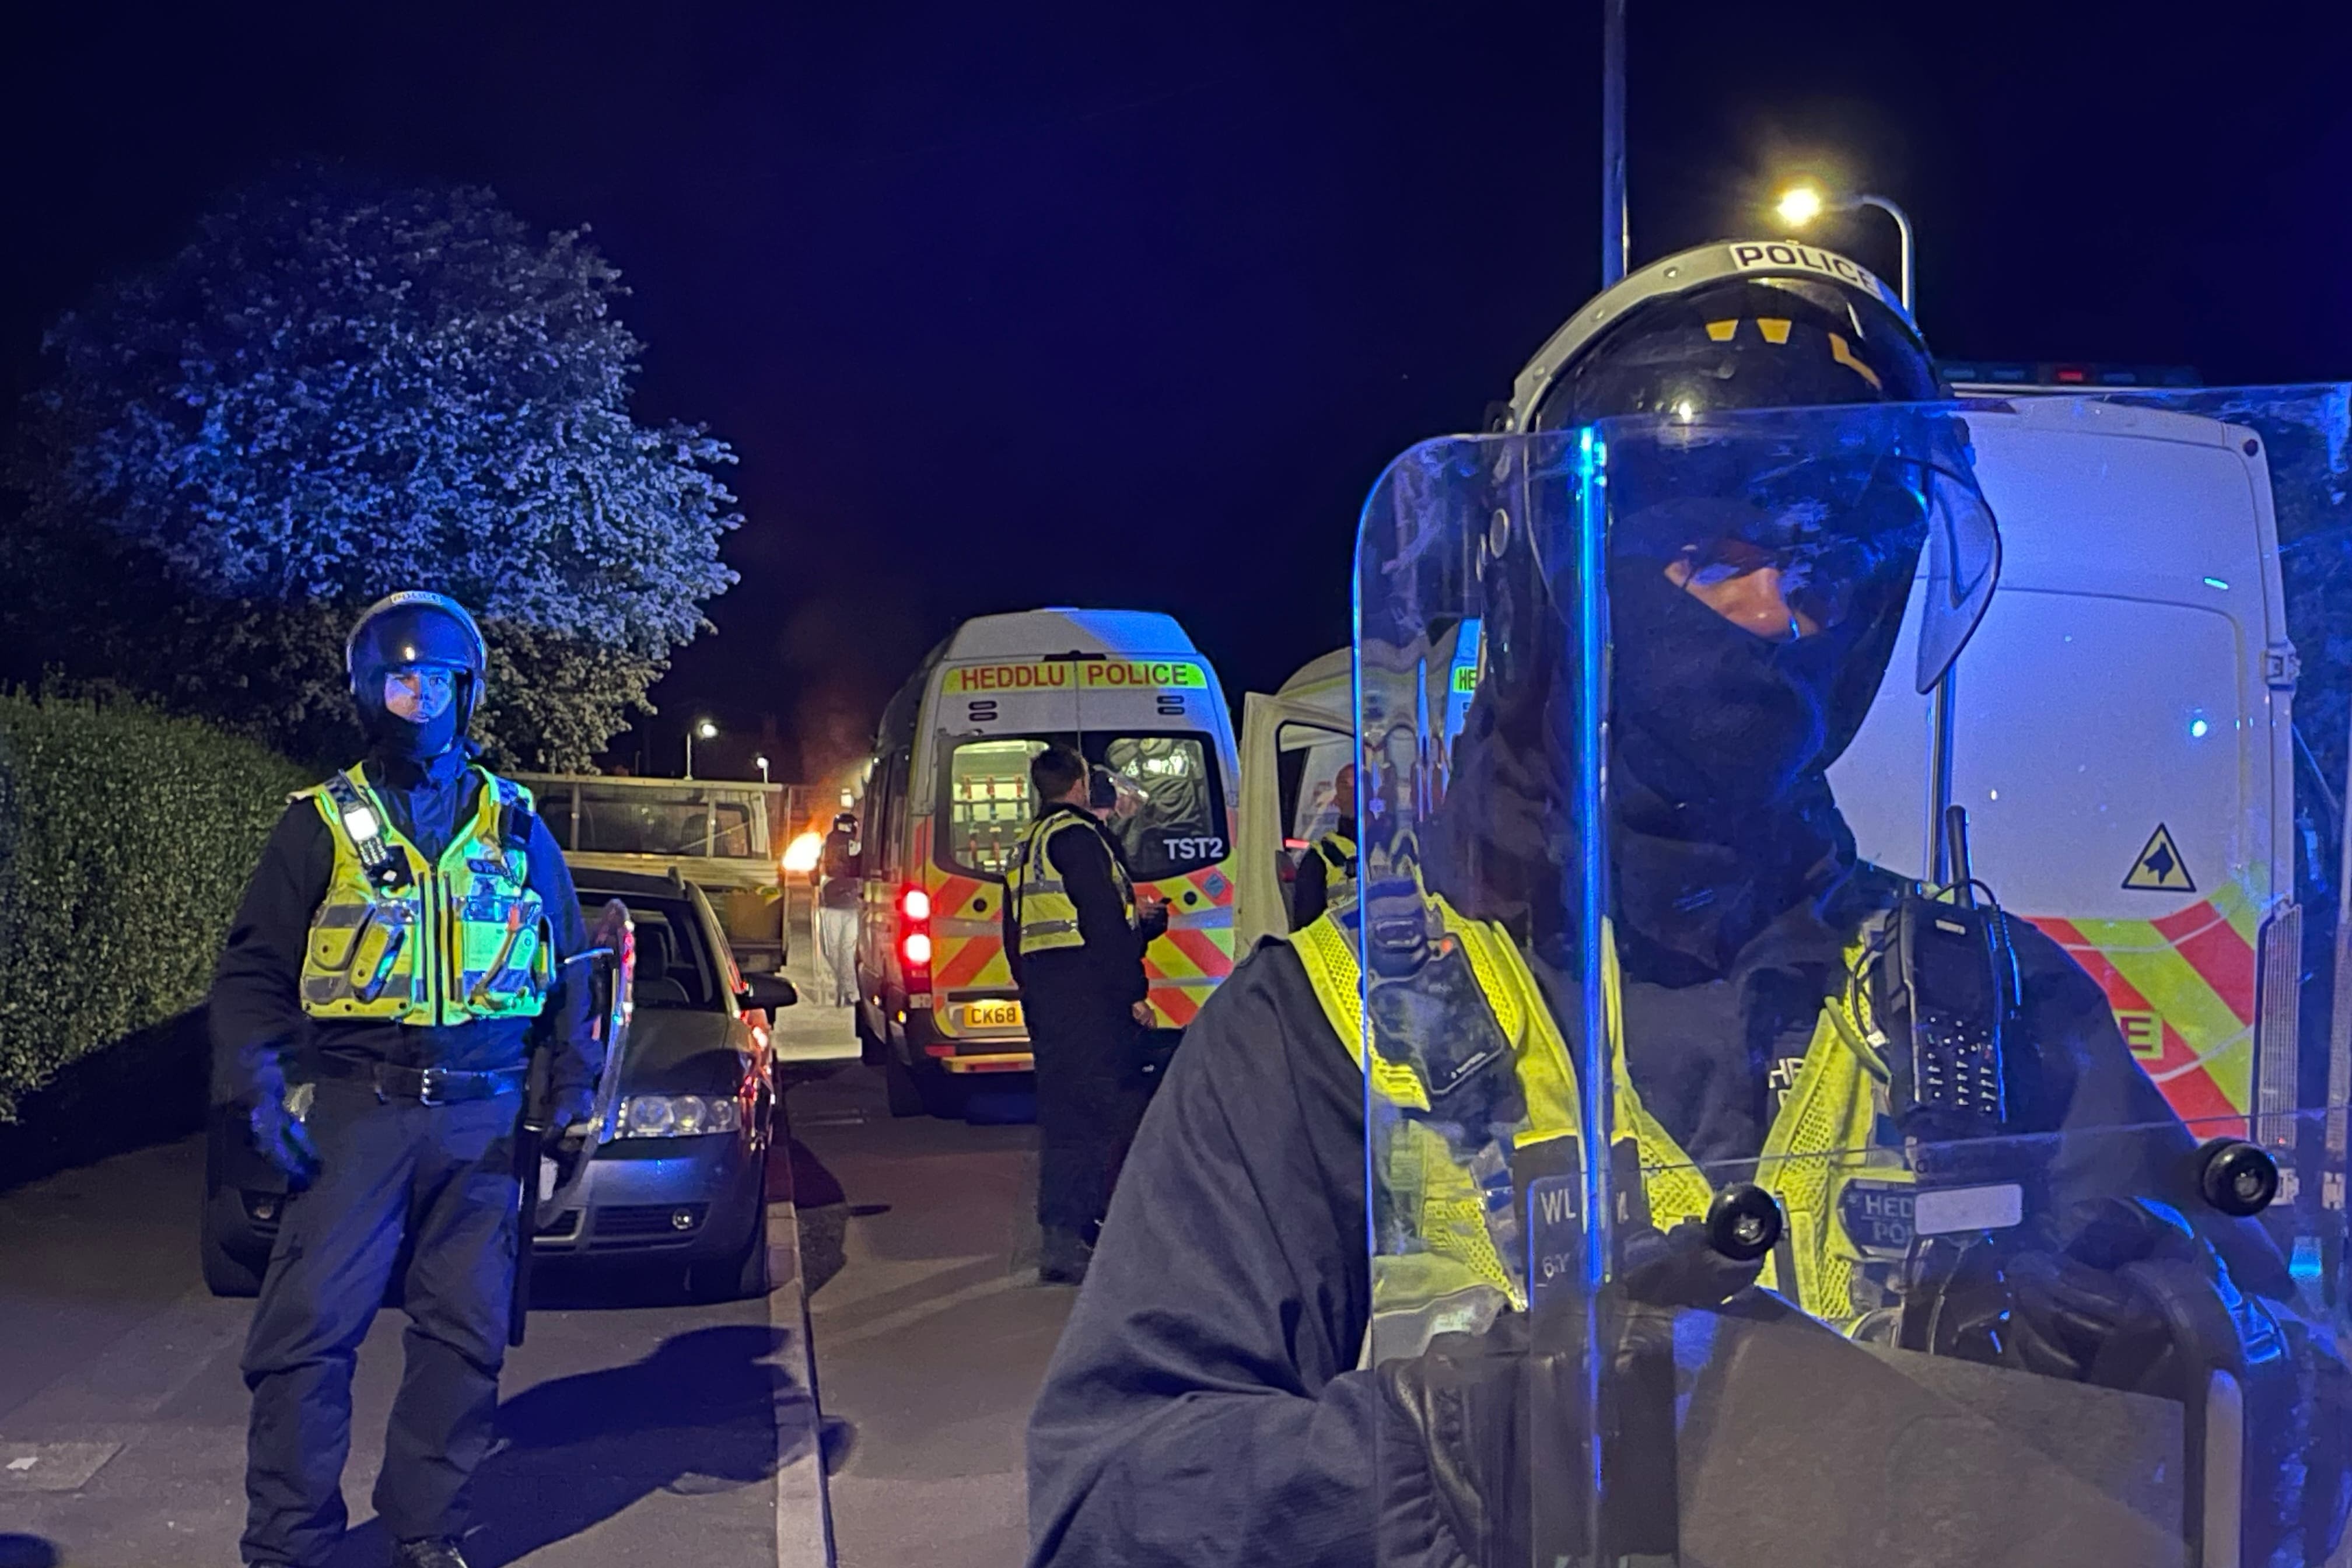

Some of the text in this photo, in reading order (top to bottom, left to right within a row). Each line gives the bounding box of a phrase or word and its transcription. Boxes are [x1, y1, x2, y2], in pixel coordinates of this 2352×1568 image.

[1735, 245, 1880, 295] POLICE
[960, 663, 1189, 691] HEDDLU POLICE
[1163, 838, 1224, 860] TST2
[971, 1006, 1016, 1024] CK68
